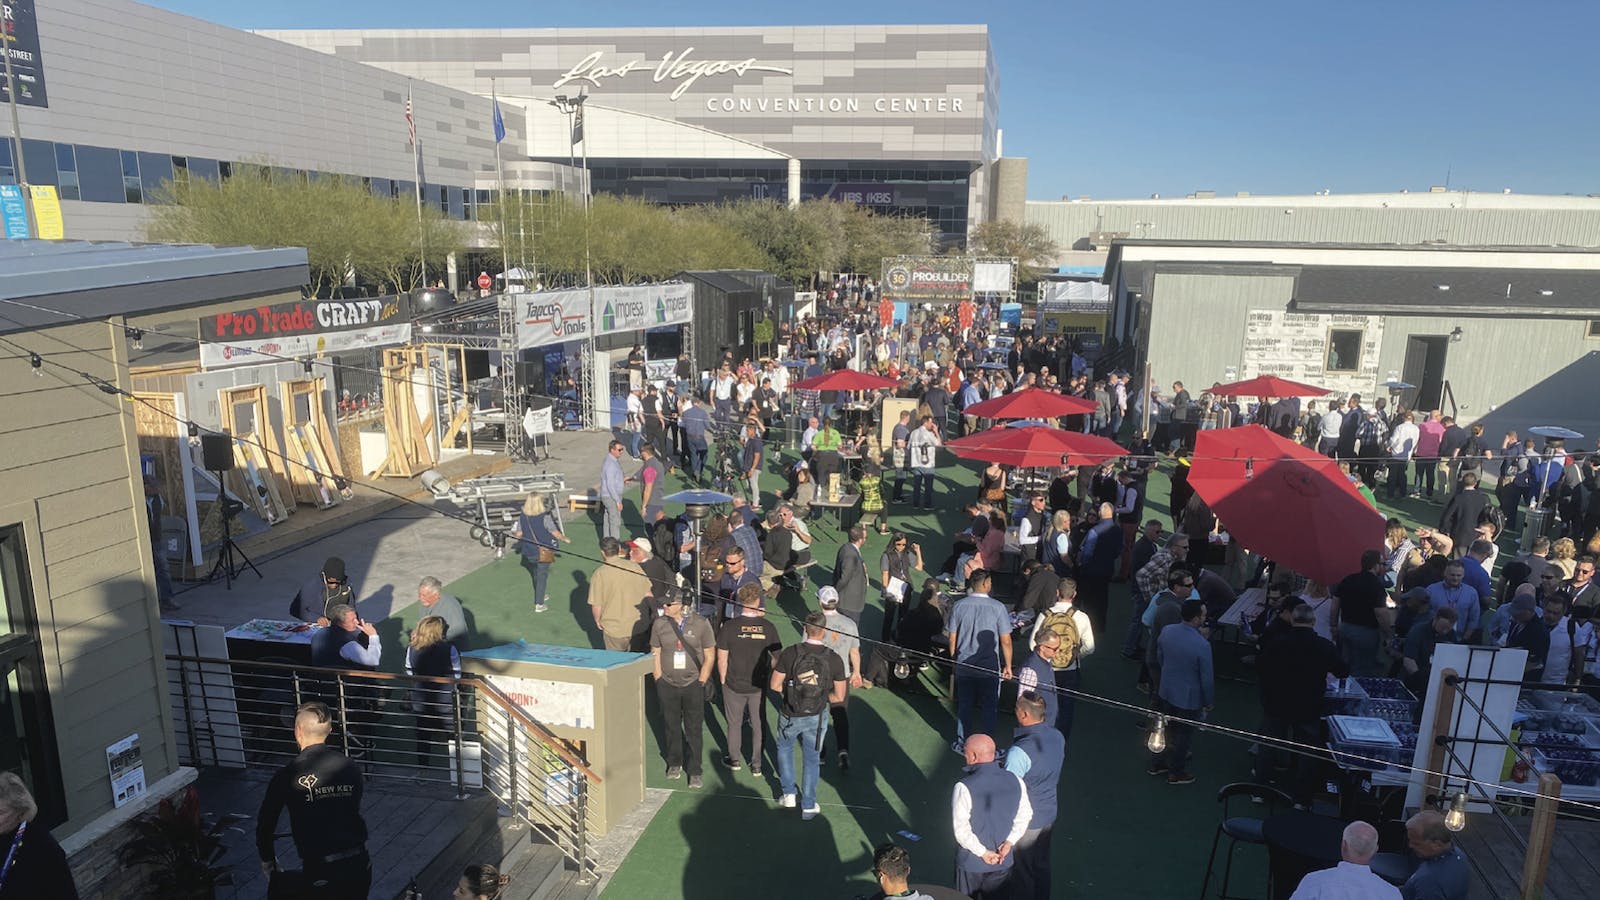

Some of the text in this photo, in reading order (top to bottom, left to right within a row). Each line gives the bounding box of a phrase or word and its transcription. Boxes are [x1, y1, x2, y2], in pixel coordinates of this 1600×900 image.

[9, 48, 32, 61] STREET
[553, 47, 793, 101] Las Vegas
[707, 97, 964, 113] CONVENTION CENTER
[912, 271, 970, 282] PROBUILDER
[526, 301, 554, 321] Tapco
[615, 299, 644, 319] impresa
[664, 295, 688, 314] impresa
[216, 312, 257, 336] Pro
[256, 304, 315, 333] Trade
[317, 300, 383, 328] CRAFT
[562, 319, 586, 336] Tools
[315, 784, 353, 795] NEW KEY
